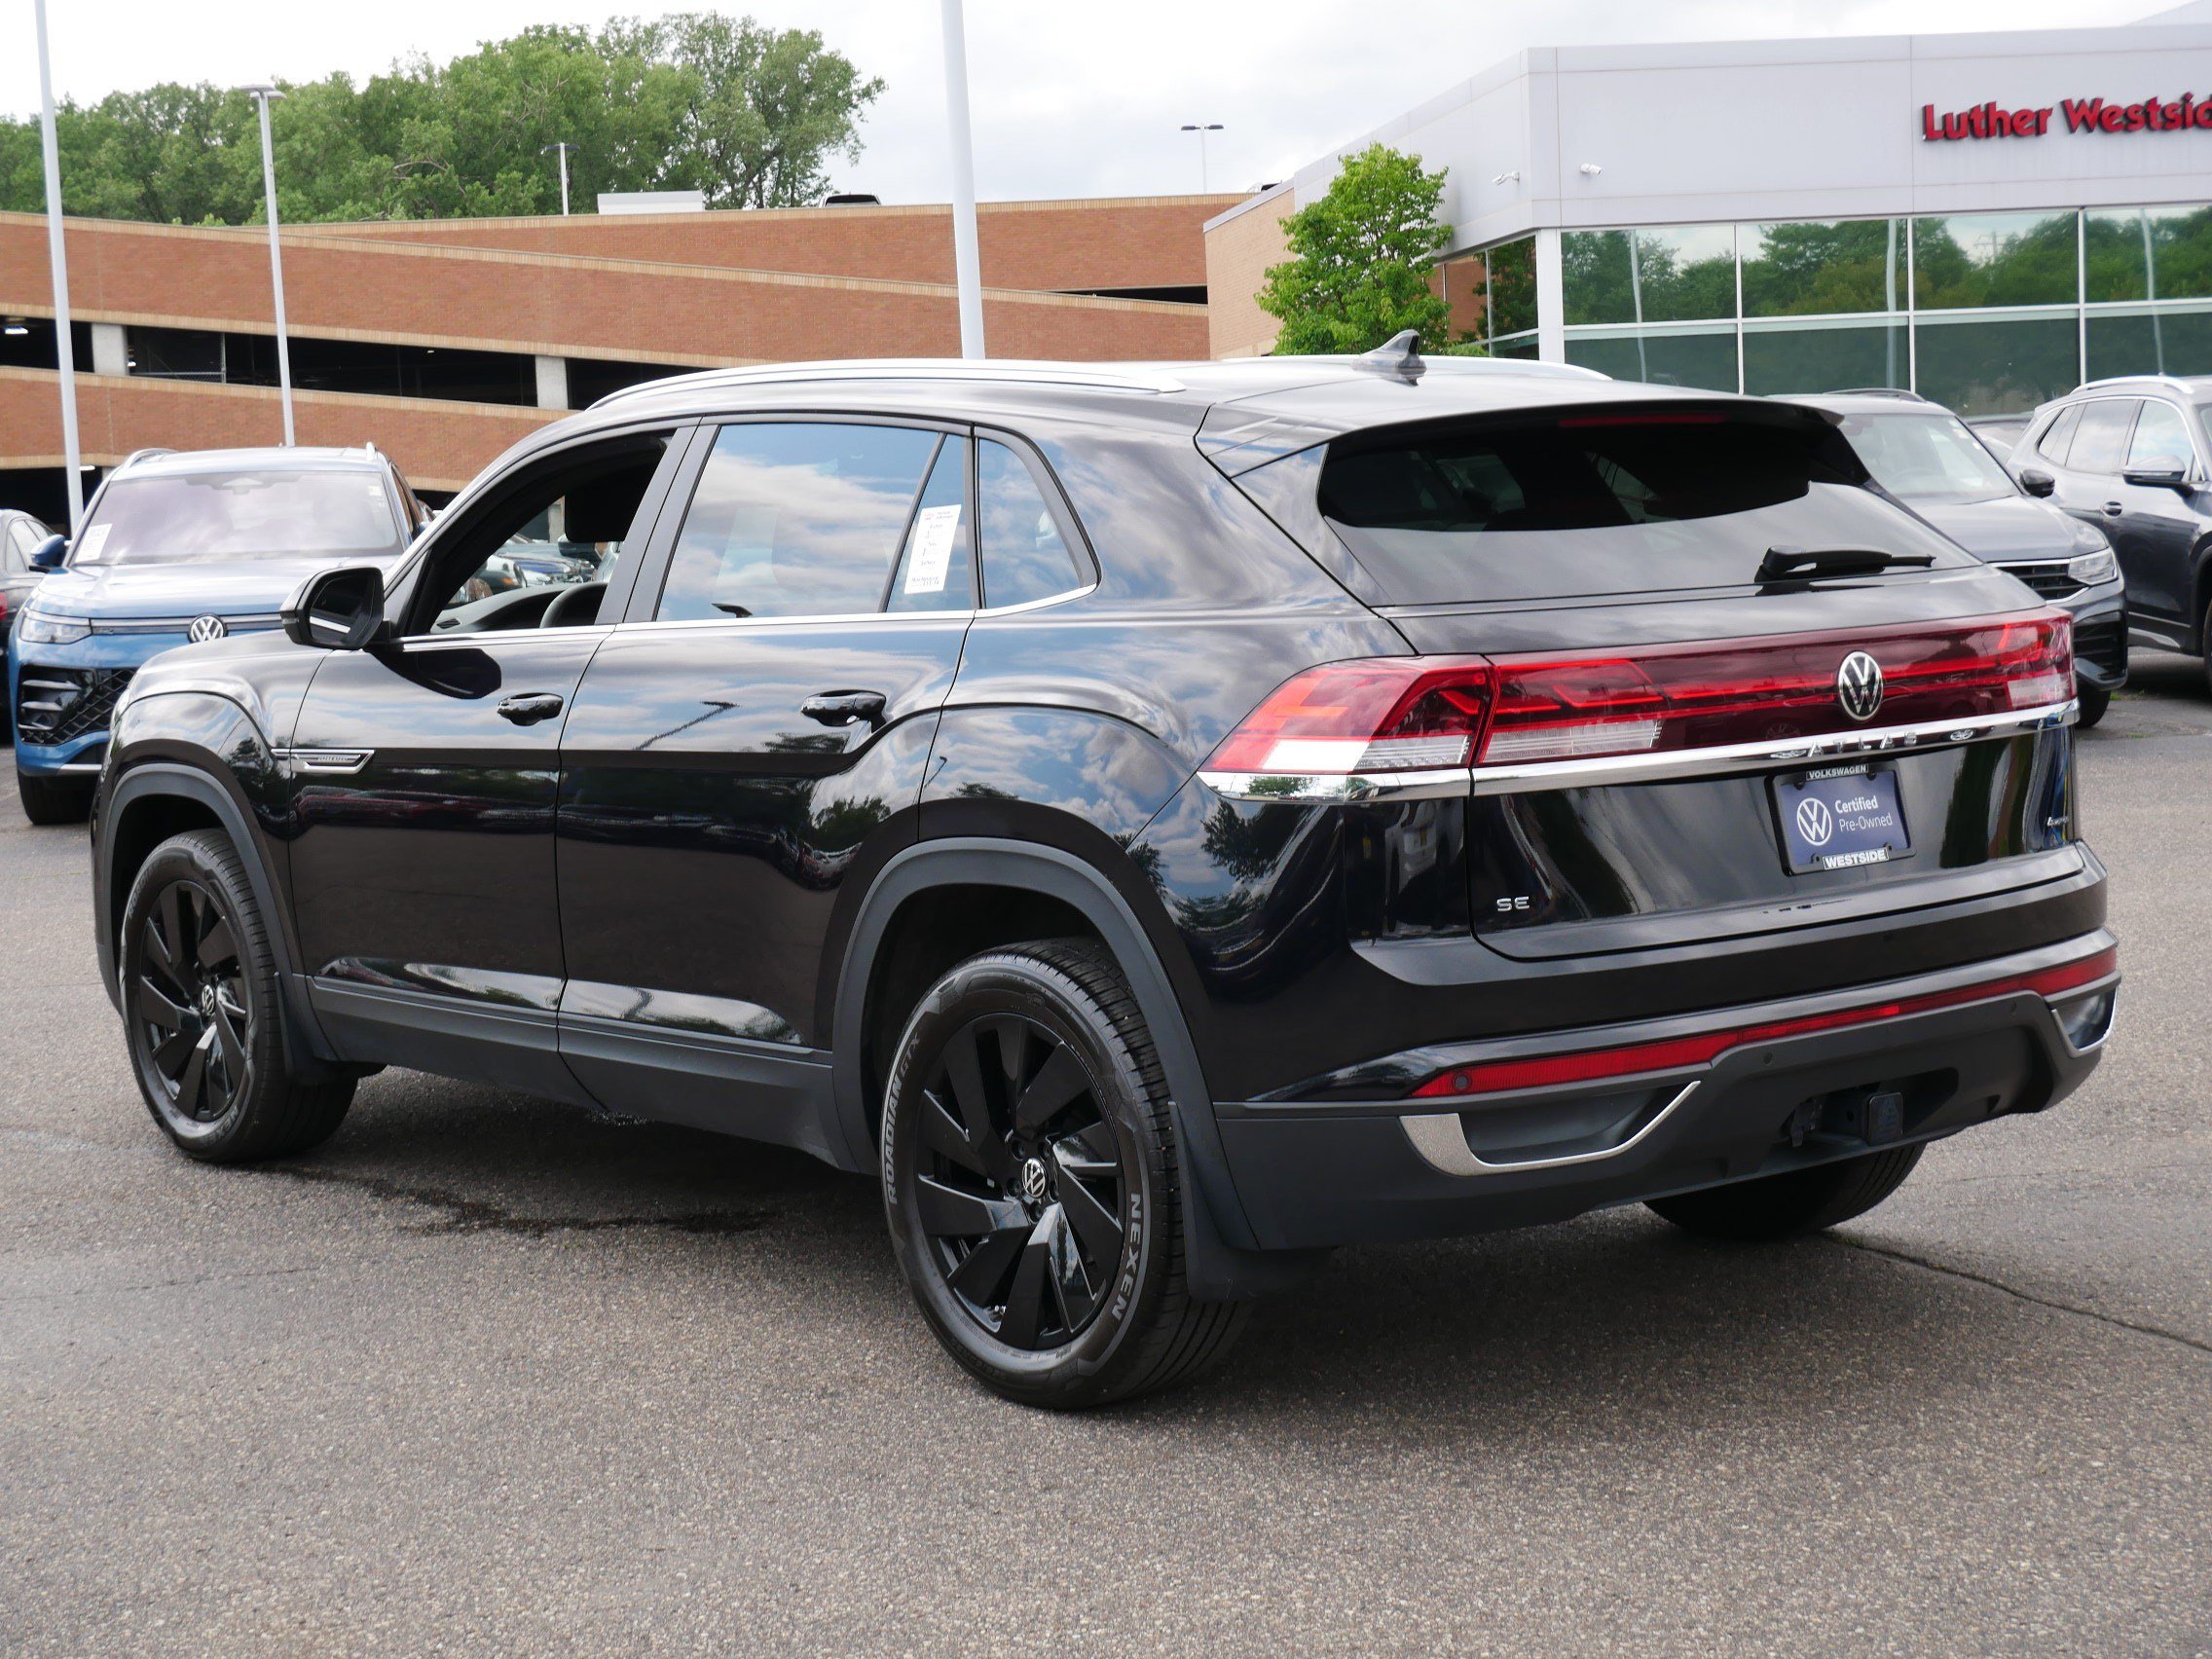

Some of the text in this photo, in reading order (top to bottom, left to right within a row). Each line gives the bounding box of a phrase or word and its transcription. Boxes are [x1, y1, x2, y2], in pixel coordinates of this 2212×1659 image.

[1923, 101, 2053, 140] Luther
[1808, 731, 1917, 757] ATLAS
[1809, 764, 1867, 779] VOLKSWAGEN
[1834, 795, 1879, 814] Certified
[1839, 812, 1893, 832] Pre-Owned
[1825, 849, 1887, 868] WESTSIDE
[1496, 896, 1530, 912] SE
[885, 1031, 921, 1204] ROADIAN GTX
[1111, 1193, 1142, 1321] NEXEN
